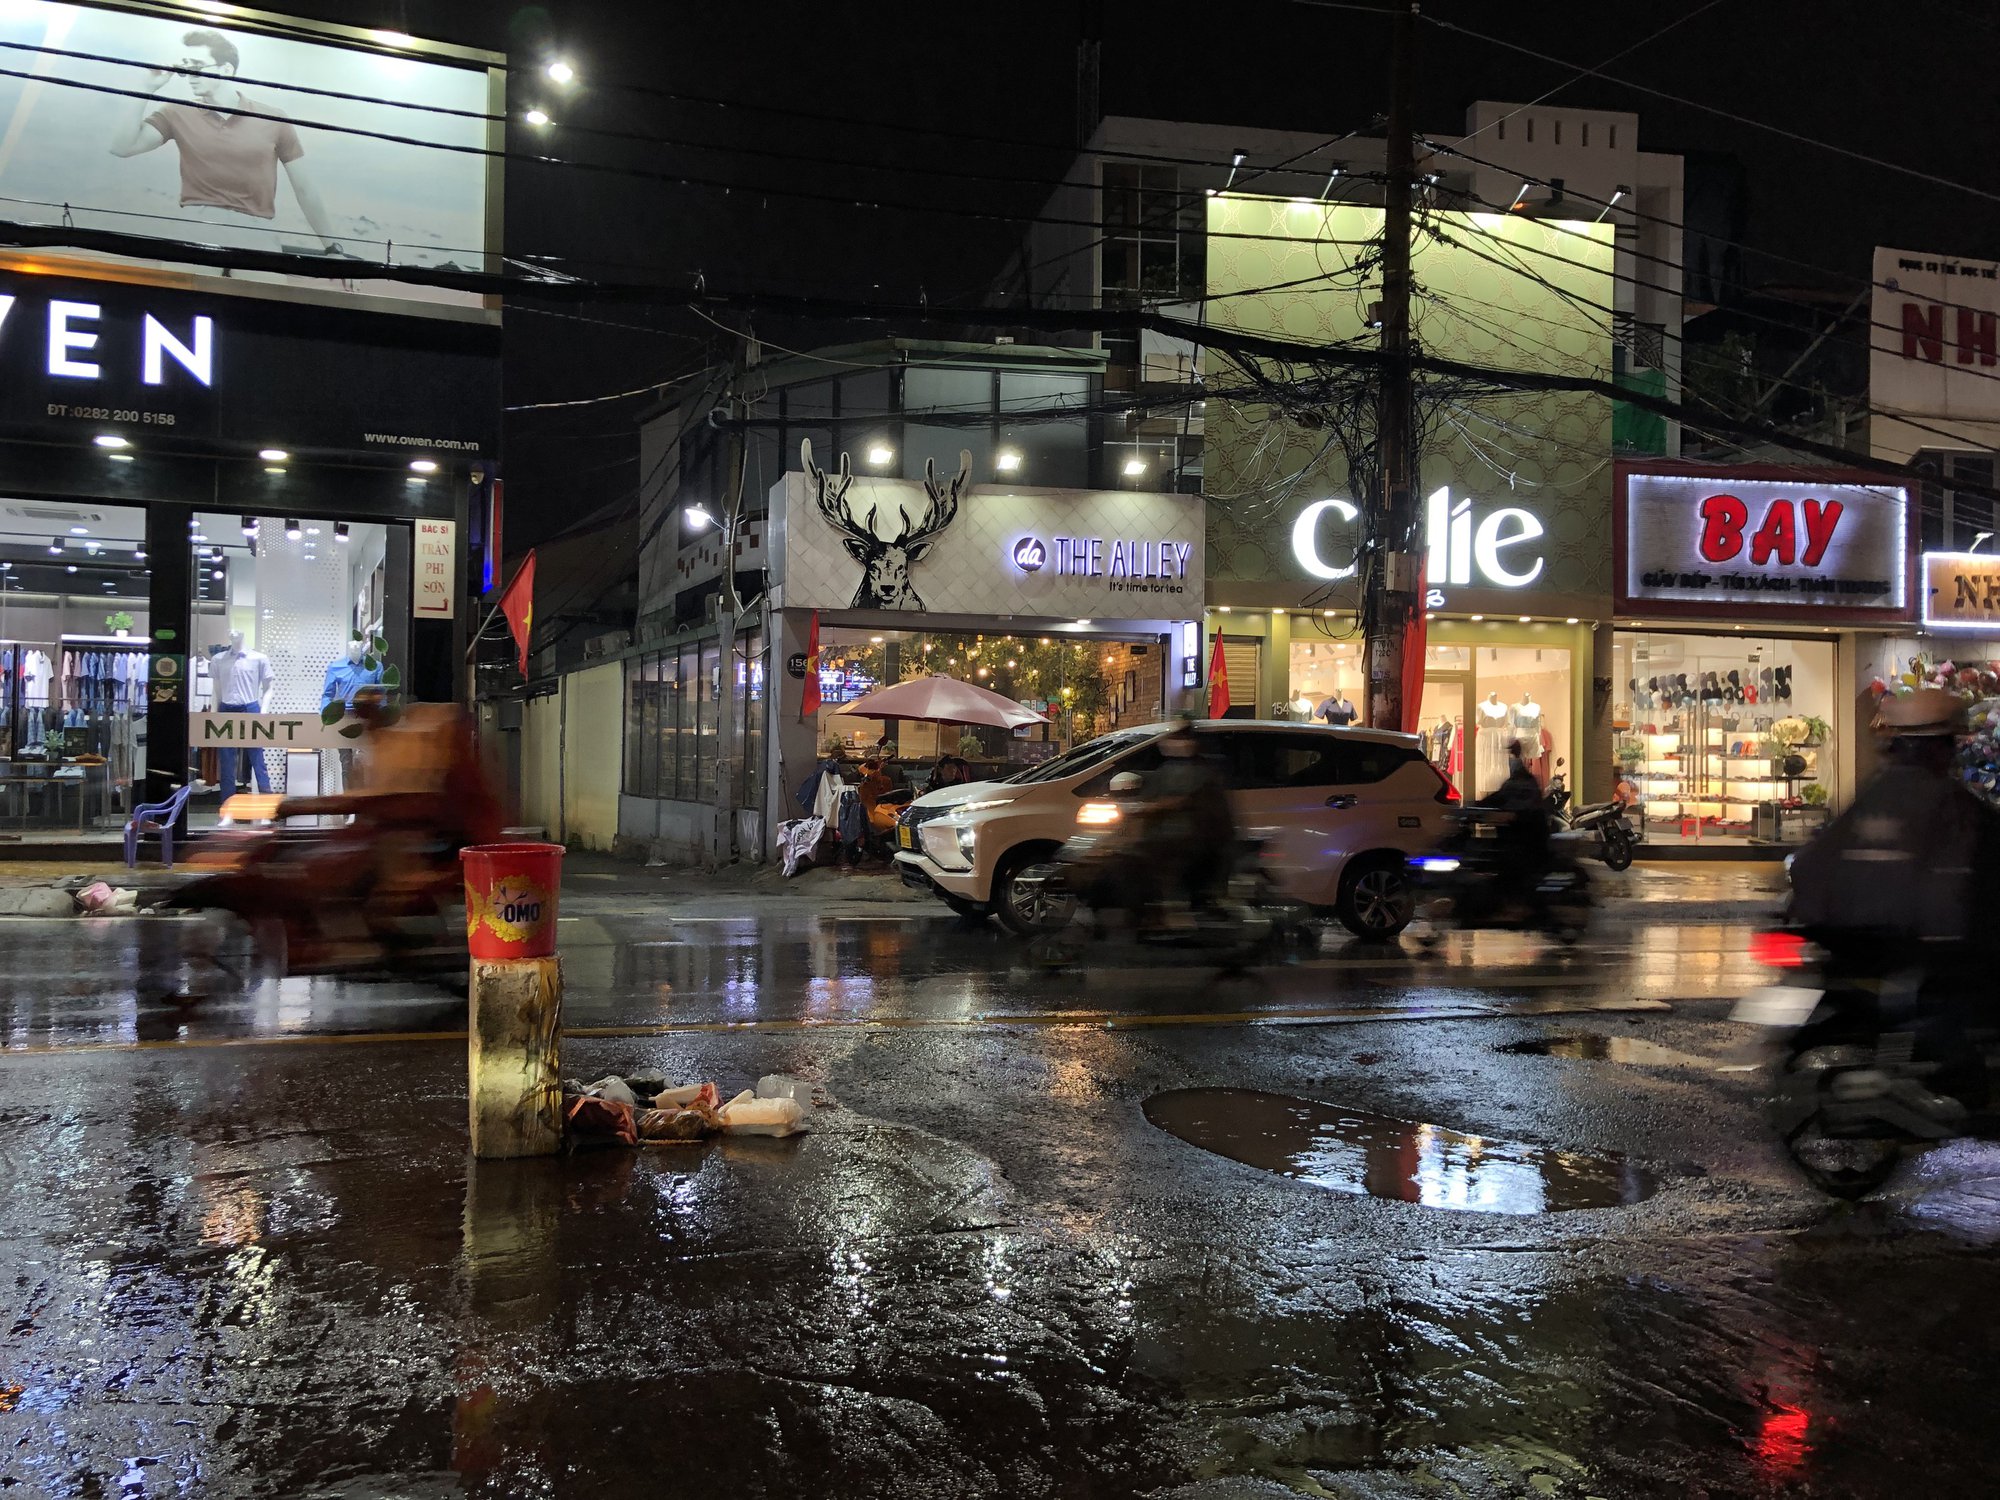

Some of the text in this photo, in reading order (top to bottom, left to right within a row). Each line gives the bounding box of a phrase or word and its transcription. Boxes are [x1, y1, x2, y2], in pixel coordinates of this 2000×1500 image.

[0, 294, 213, 388] EN
[1902, 303, 1997, 367] NH
[113, 409, 139, 422] 200
[143, 412, 175, 426] 5158
[364, 433, 479, 451] www.owen.com.vn
[1293, 486, 1544, 587] clie
[1700, 494, 1844, 566] BAY
[425, 562, 445, 575] PHI
[1054, 537, 1190, 580] THE ALLEY
[423, 580, 445, 593] SƠN
[1109, 581, 1183, 594] It's time for tea
[1271, 701, 1290, 715] 154
[204, 719, 303, 741] MINT
[504, 903, 541, 923] OMO
